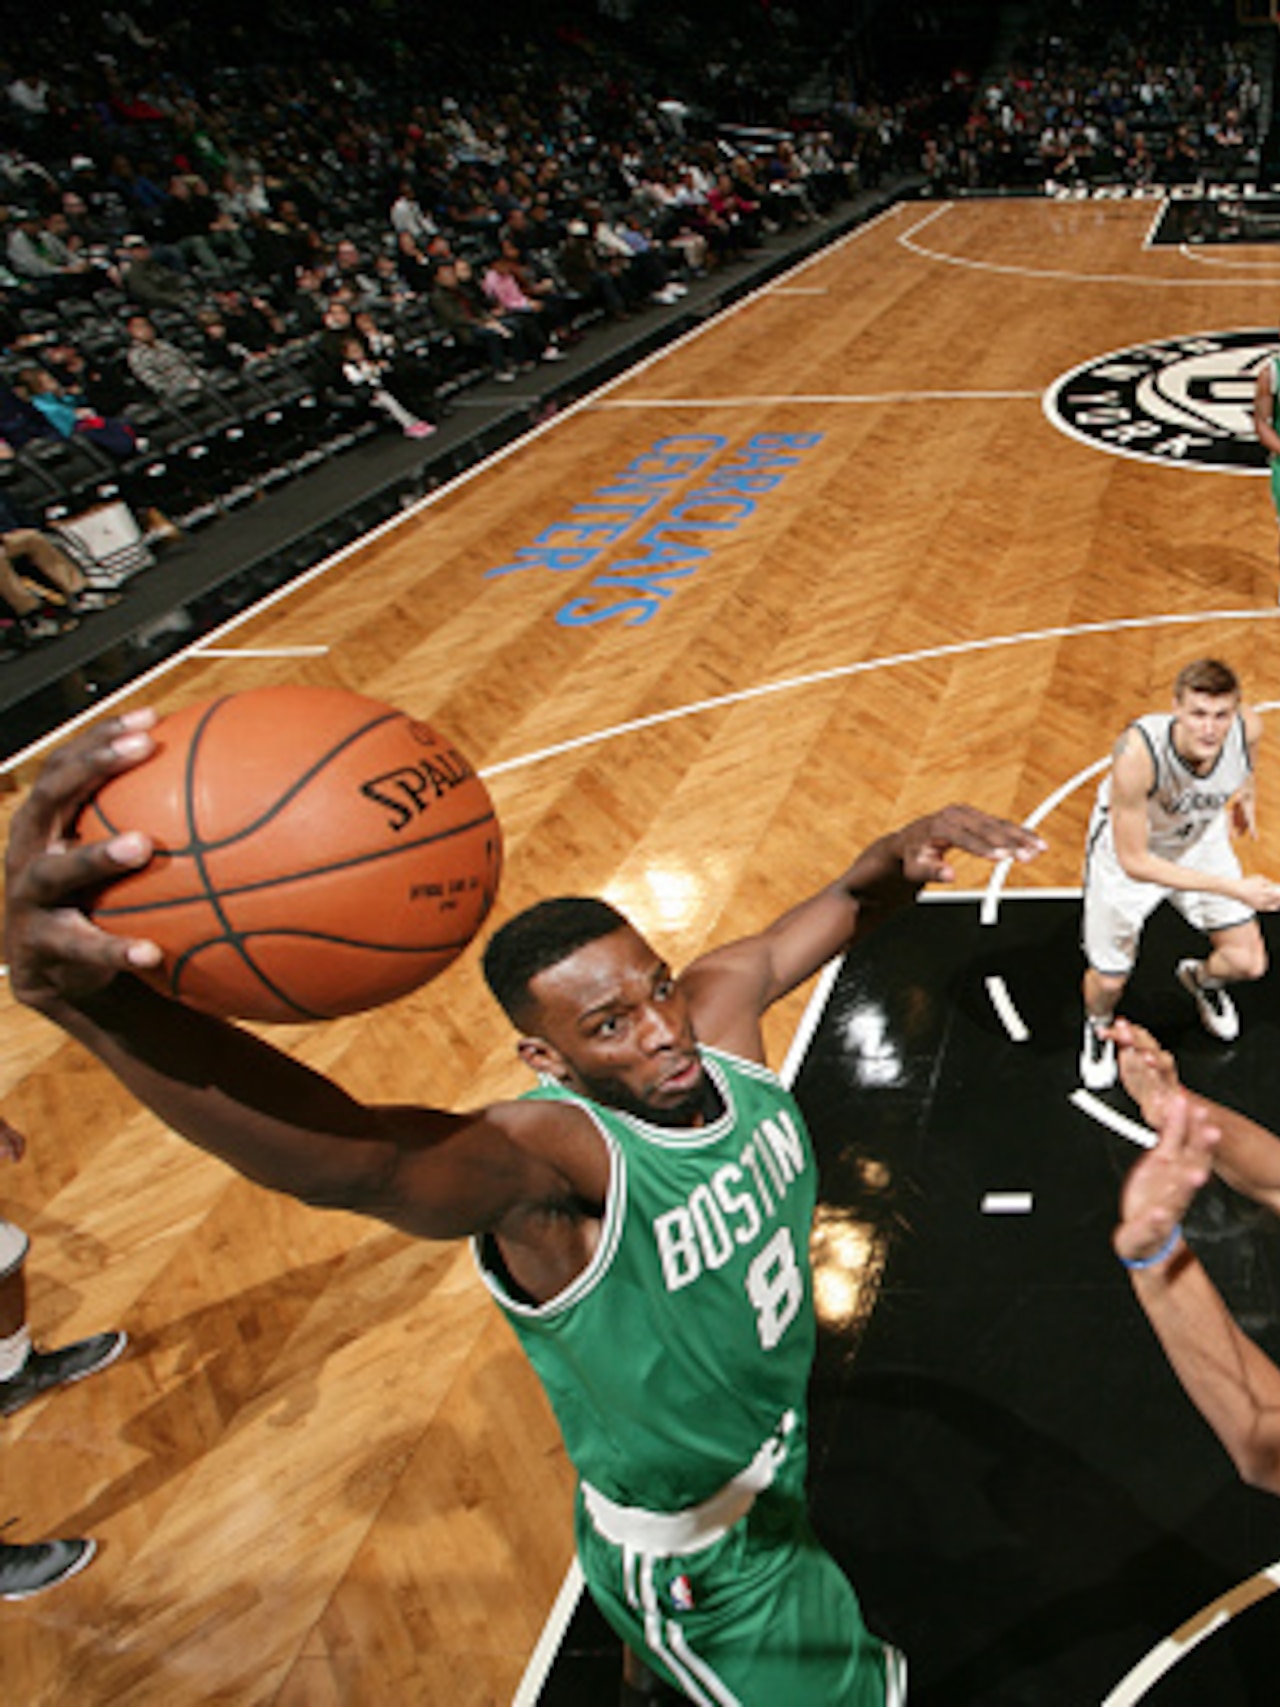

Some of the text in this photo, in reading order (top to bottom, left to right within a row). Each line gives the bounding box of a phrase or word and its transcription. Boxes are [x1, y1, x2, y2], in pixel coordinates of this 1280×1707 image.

[482, 432, 730, 580] CENTER
[554, 430, 828, 627] BARCLAYS
[744, 1226, 804, 1351] 8
